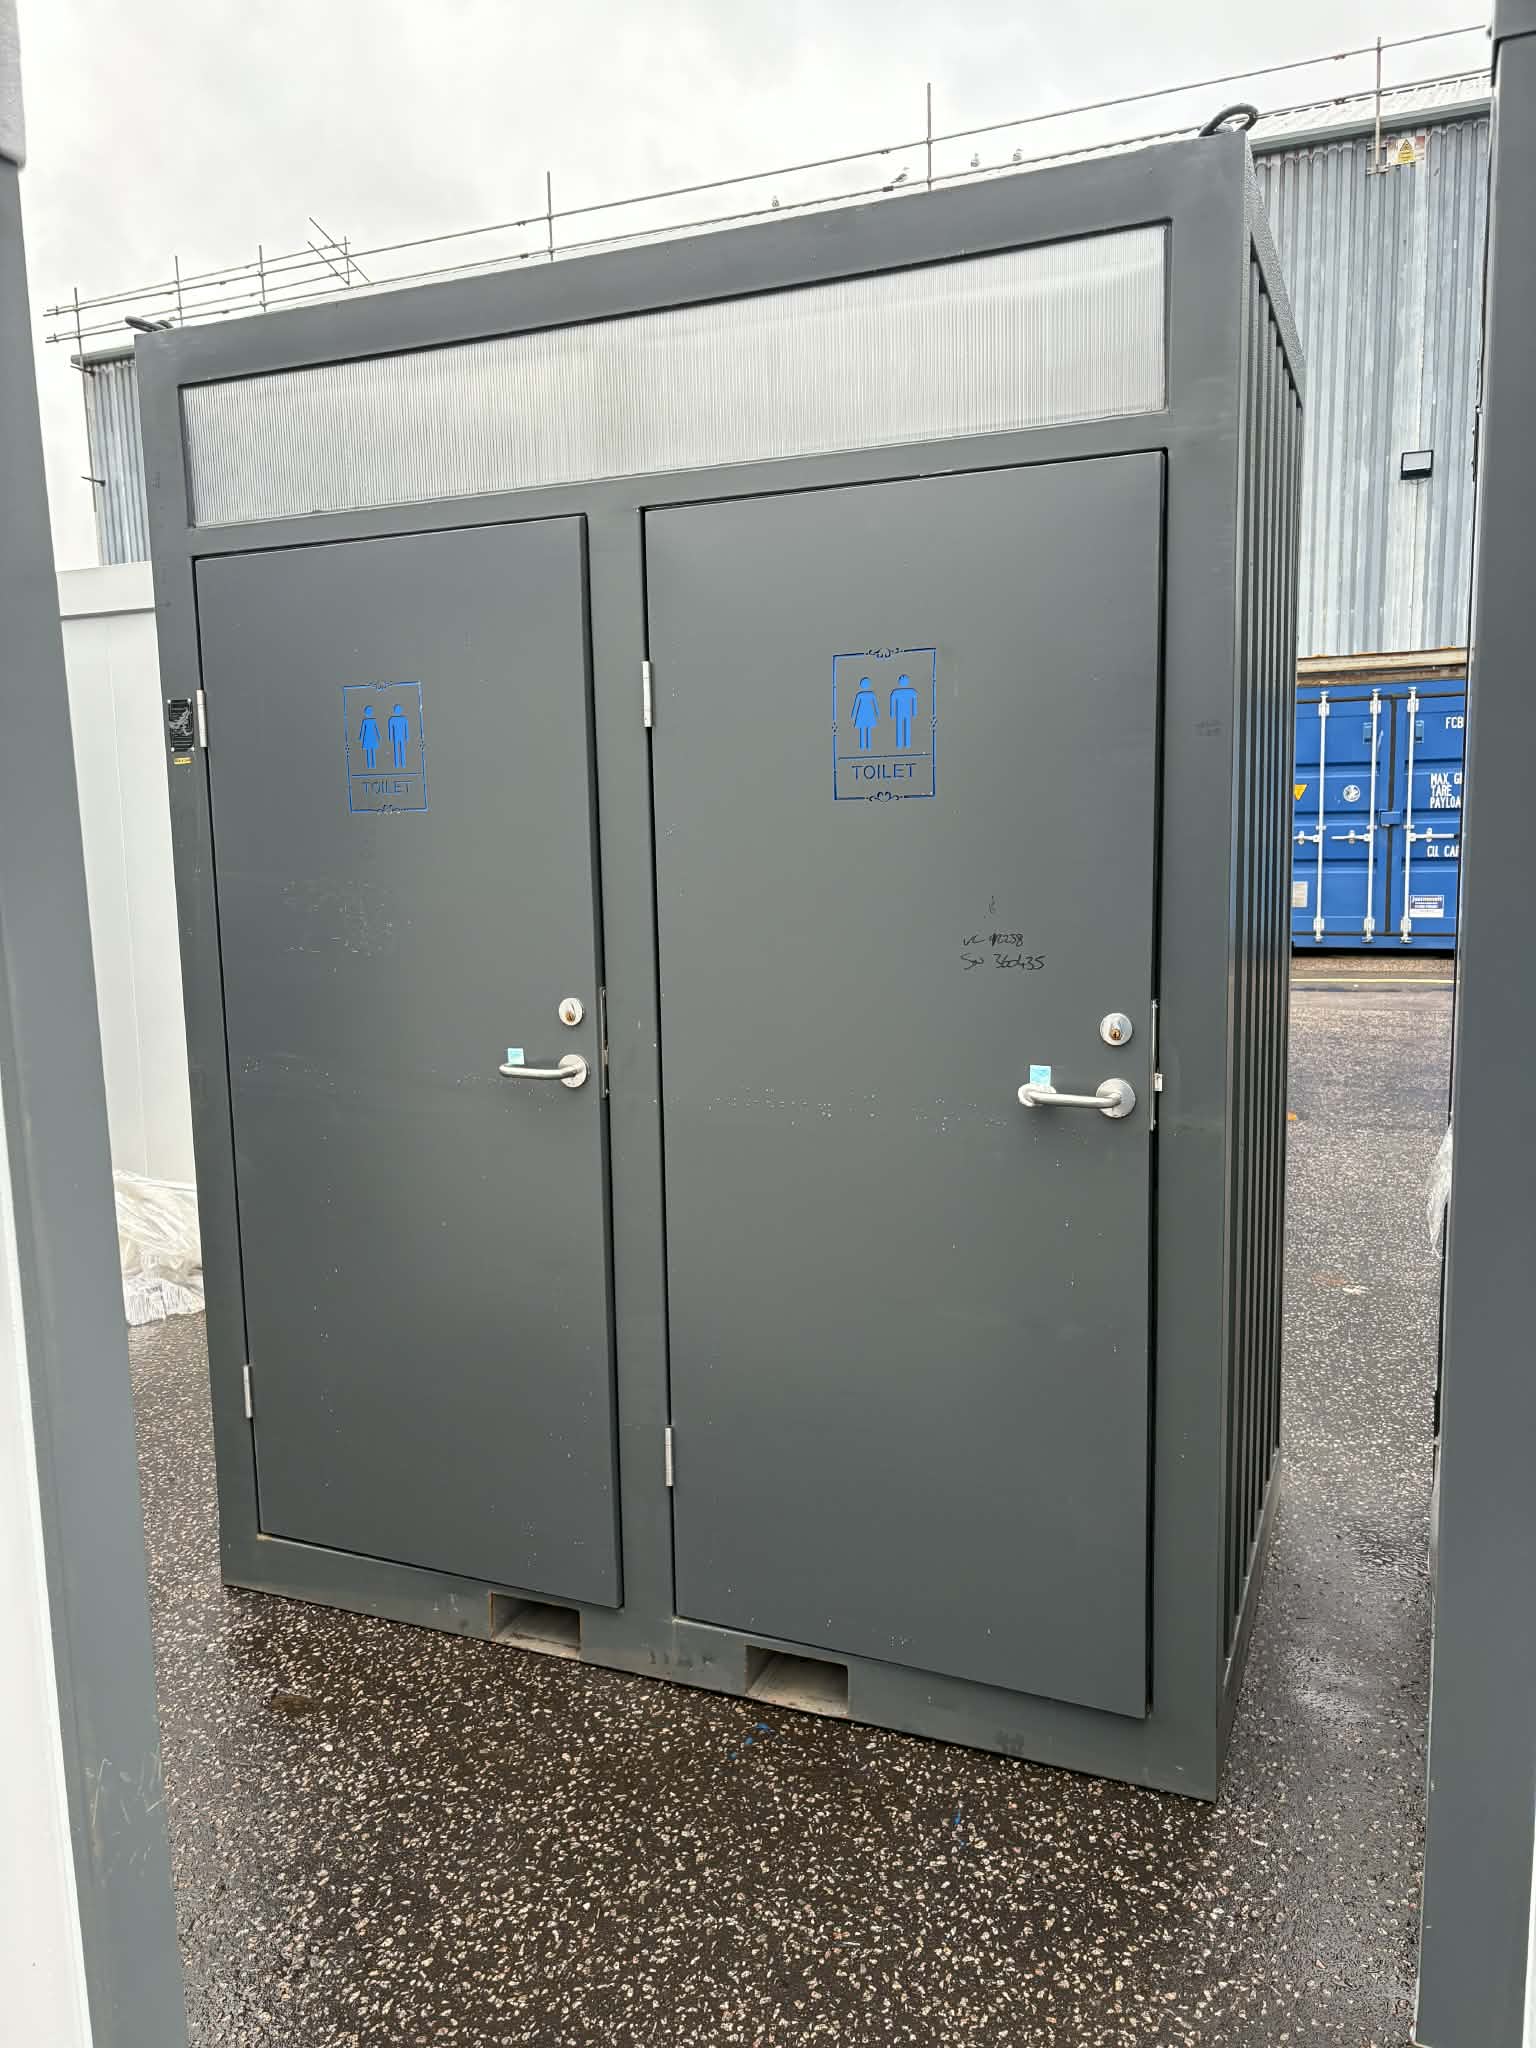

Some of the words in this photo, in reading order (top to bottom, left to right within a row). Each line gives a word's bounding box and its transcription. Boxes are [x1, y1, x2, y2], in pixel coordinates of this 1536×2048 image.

[851, 763, 916, 780] TOILET
[361, 779, 414, 794] TOILET
[1430, 784, 1453, 797] TARE
